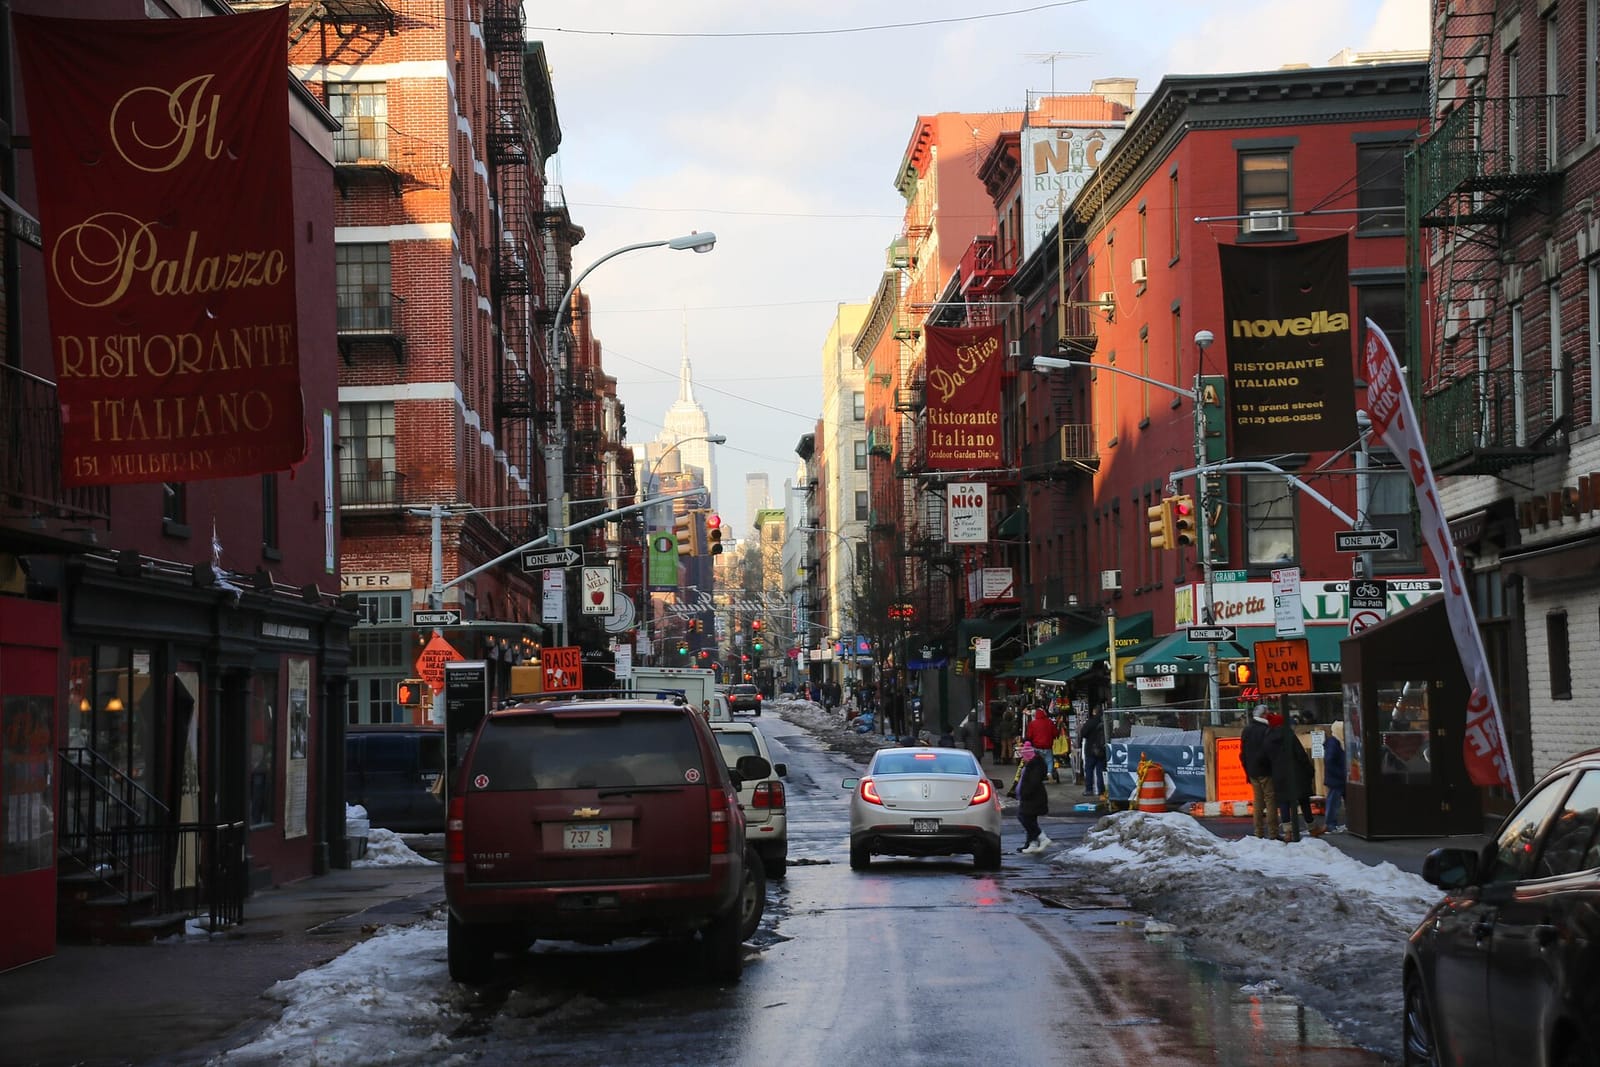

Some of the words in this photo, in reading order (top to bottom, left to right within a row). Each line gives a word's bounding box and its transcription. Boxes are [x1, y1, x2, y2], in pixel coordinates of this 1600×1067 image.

[110, 74, 223, 172] Il
[1056, 130, 1106, 141] DA
[1035, 174, 1092, 191] RISTO
[53, 212, 287, 307] Palazzo
[1232, 311, 1349, 338] novella
[57, 322, 295, 379] RISTORANTE
[929, 364, 966, 403] Da
[956, 335, 999, 374] Nico
[1234, 358, 1324, 372] RISTORANTE
[1235, 377, 1300, 388] ITALIANO
[1259, 403, 1289, 412] grand
[1292, 400, 1324, 409] street
[93, 390, 274, 441] ITALIANO
[929, 407, 998, 425] Ristorante
[1238, 414, 1266, 425] (212)
[932, 429, 994, 446] Italiano
[954, 449, 976, 459] Garden
[74, 456, 100, 477] 151
[111, 450, 213, 476] MULBERRY
[951, 495, 983, 508] NICO
[1370, 536, 1388, 544] WAY
[530, 556, 549, 565] ONE
[556, 552, 575, 562] WAY
[586, 570, 600, 582] LA
[1215, 573, 1236, 582] GRAND
[587, 577, 609, 591] MELA
[1213, 597, 1266, 620] Ricotta
[1269, 646, 1292, 658] LIFT
[545, 651, 577, 668] RAISE
[1154, 664, 1178, 674] 188
[1266, 662, 1297, 672] PLOW
[1264, 676, 1303, 688] BLADE
[570, 831, 589, 843] 737
